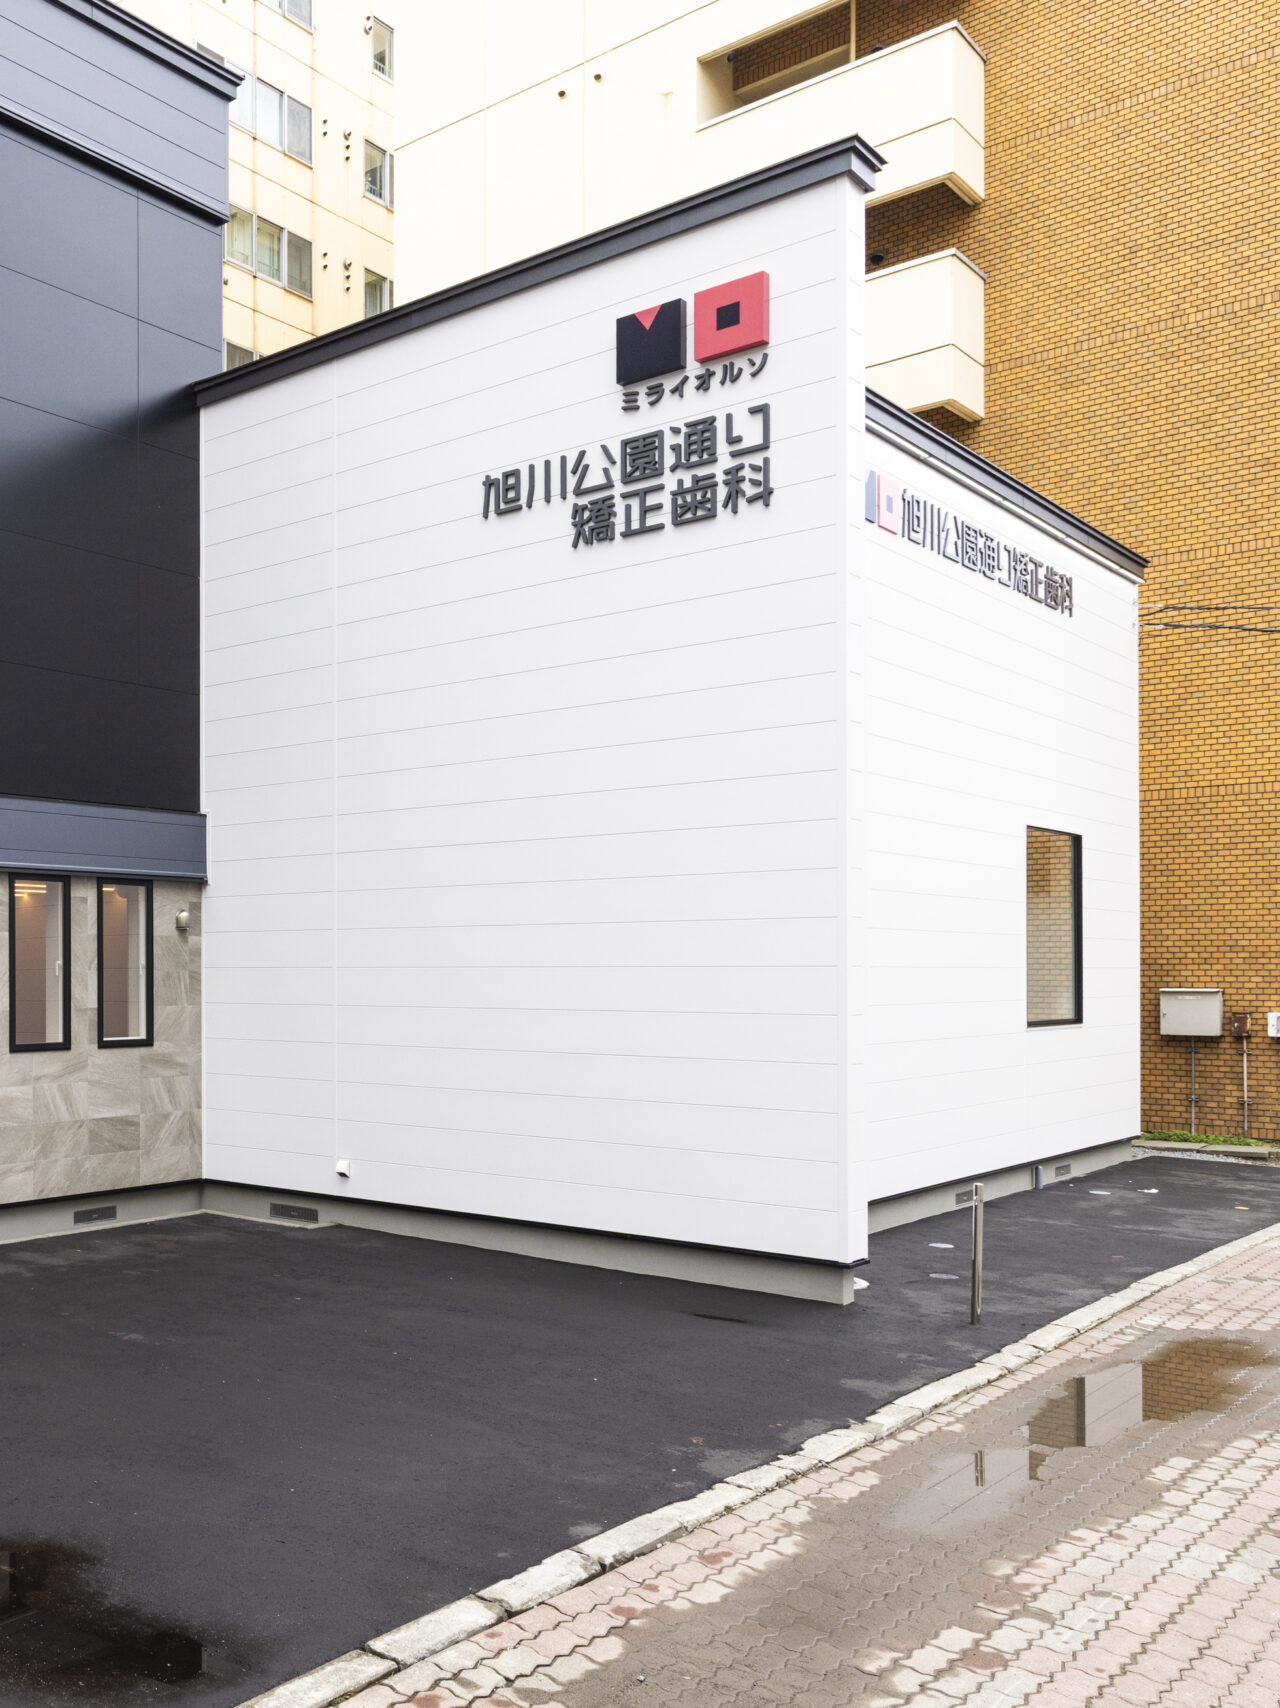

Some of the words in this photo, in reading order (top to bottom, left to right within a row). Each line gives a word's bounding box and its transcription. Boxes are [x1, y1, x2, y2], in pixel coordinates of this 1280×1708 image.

[621, 353, 769, 412] ミライオルソ
[482, 403, 771, 519] 旭川公園通り
[571, 457, 775, 549] 矯正歯科
[901, 488, 1074, 618] 旭川公園通り矯正歯科
